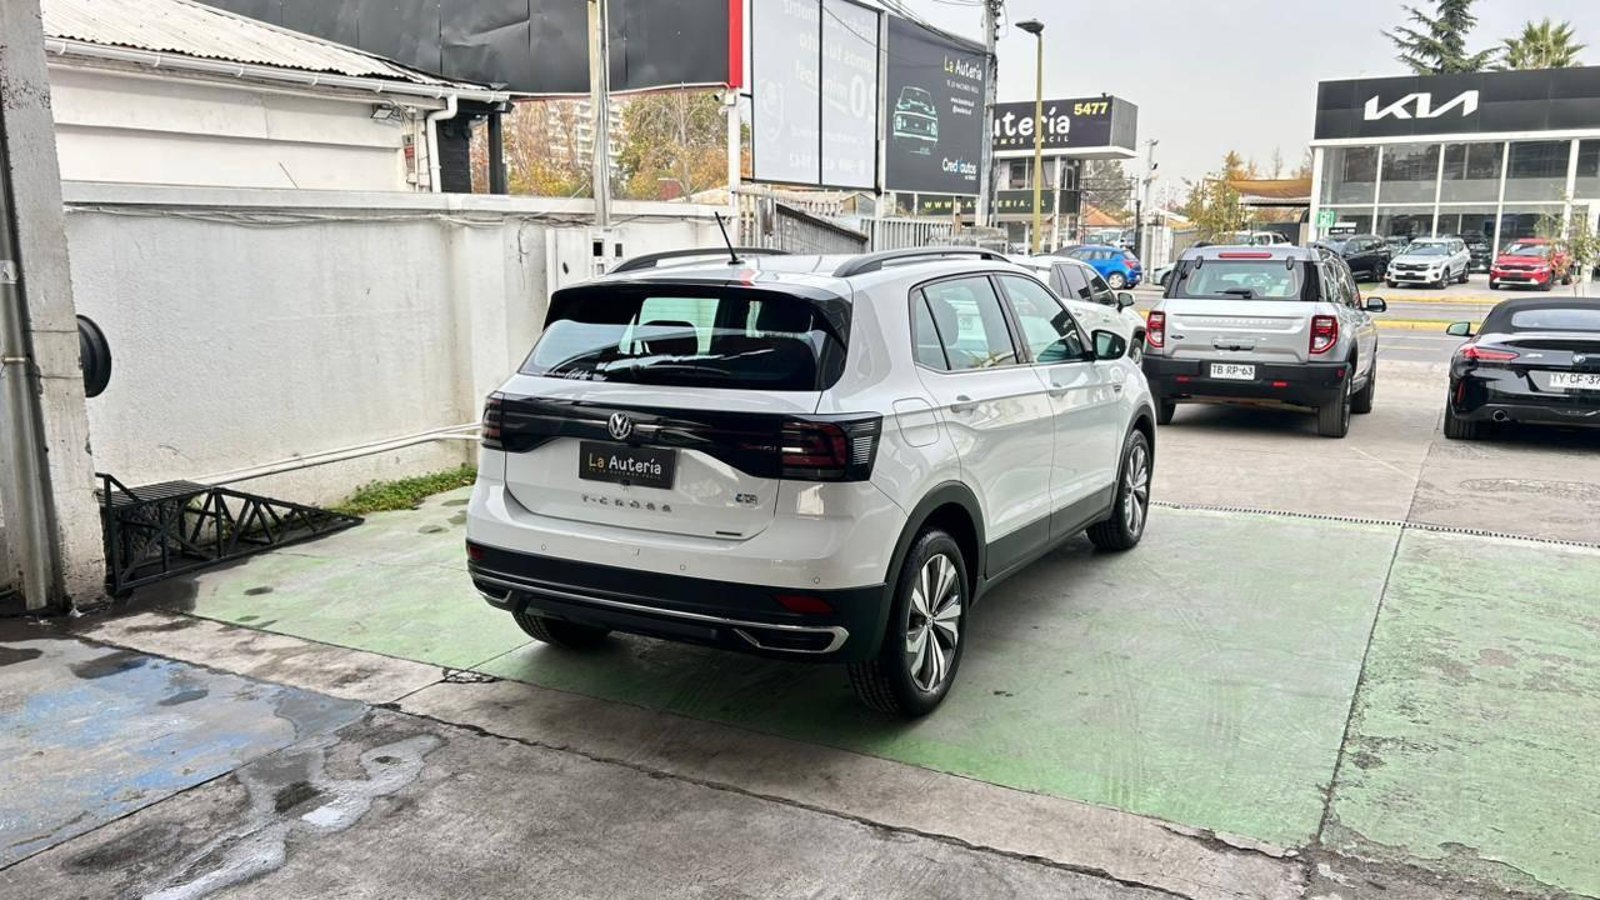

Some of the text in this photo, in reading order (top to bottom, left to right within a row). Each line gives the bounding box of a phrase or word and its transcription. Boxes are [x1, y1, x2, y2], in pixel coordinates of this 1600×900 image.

[944, 54, 954, 73] La
[1073, 101, 1109, 116] 5477
[1363, 90, 1480, 121] KIA
[589, 452, 605, 469] La
[608, 455, 662, 475] Autería
